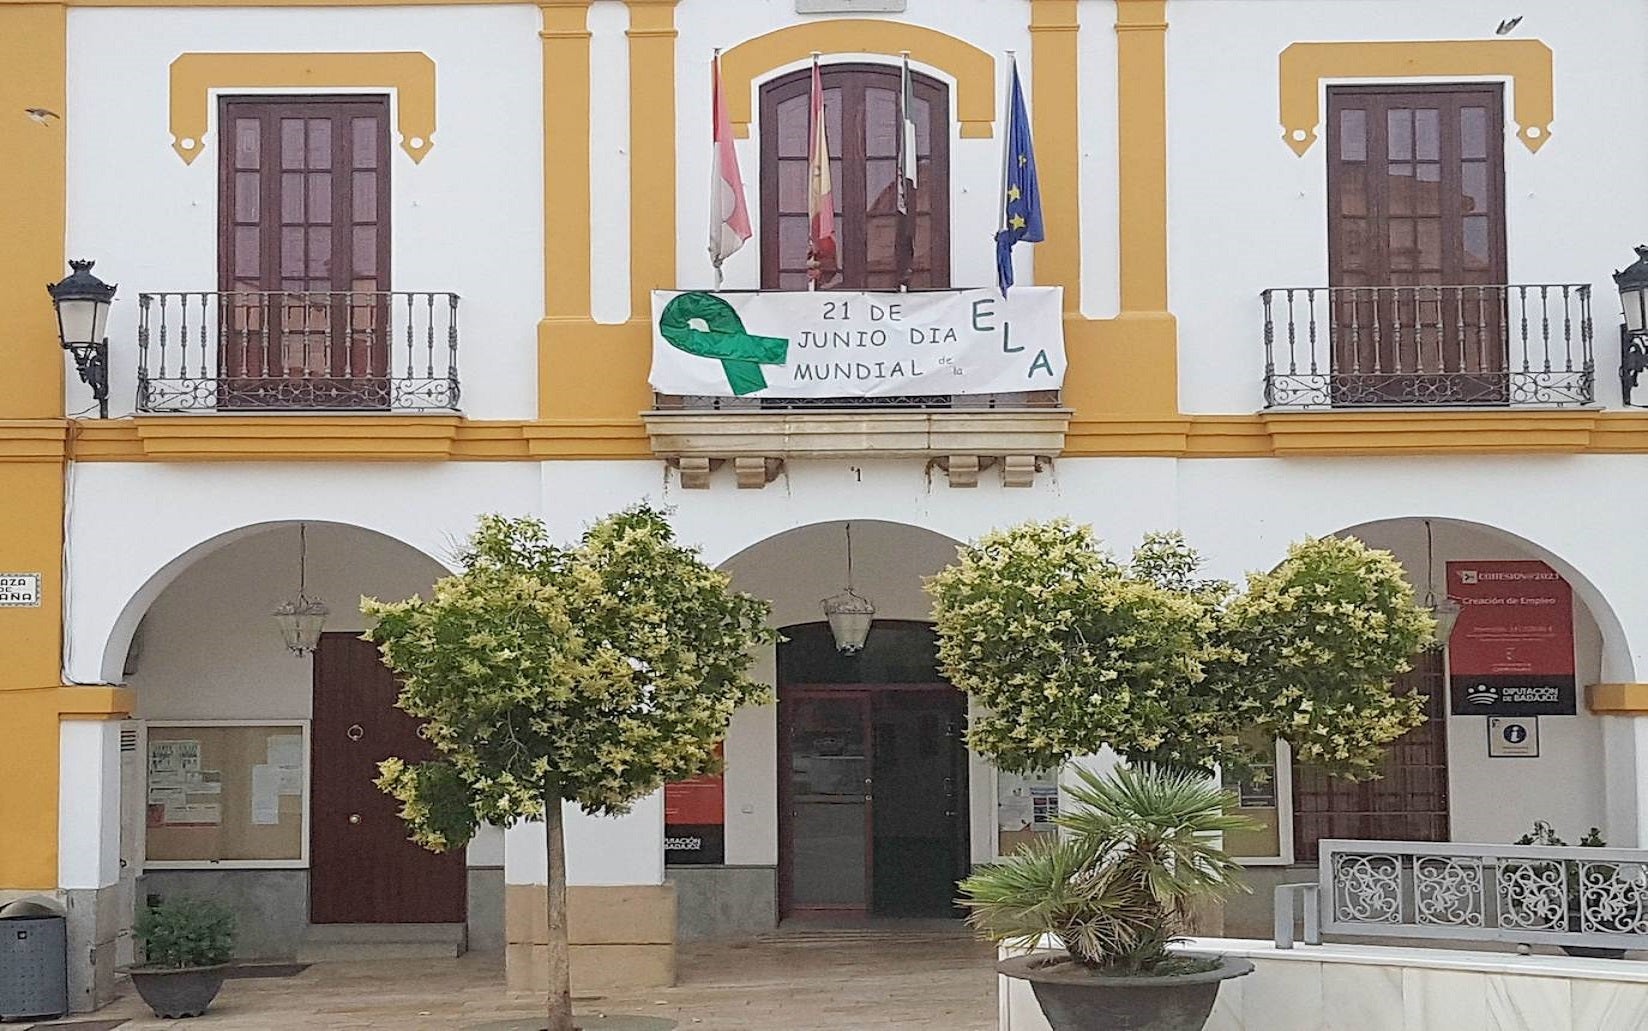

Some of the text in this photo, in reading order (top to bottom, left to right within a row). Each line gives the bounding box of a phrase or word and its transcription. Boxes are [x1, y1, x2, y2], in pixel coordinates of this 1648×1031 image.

[823, 301, 901, 322] 21 DE
[798, 327, 958, 349] JUNIO DIA
[794, 359, 924, 381] MUNDIAL
[938, 355, 953, 365] de
[953, 366, 964, 376] la
